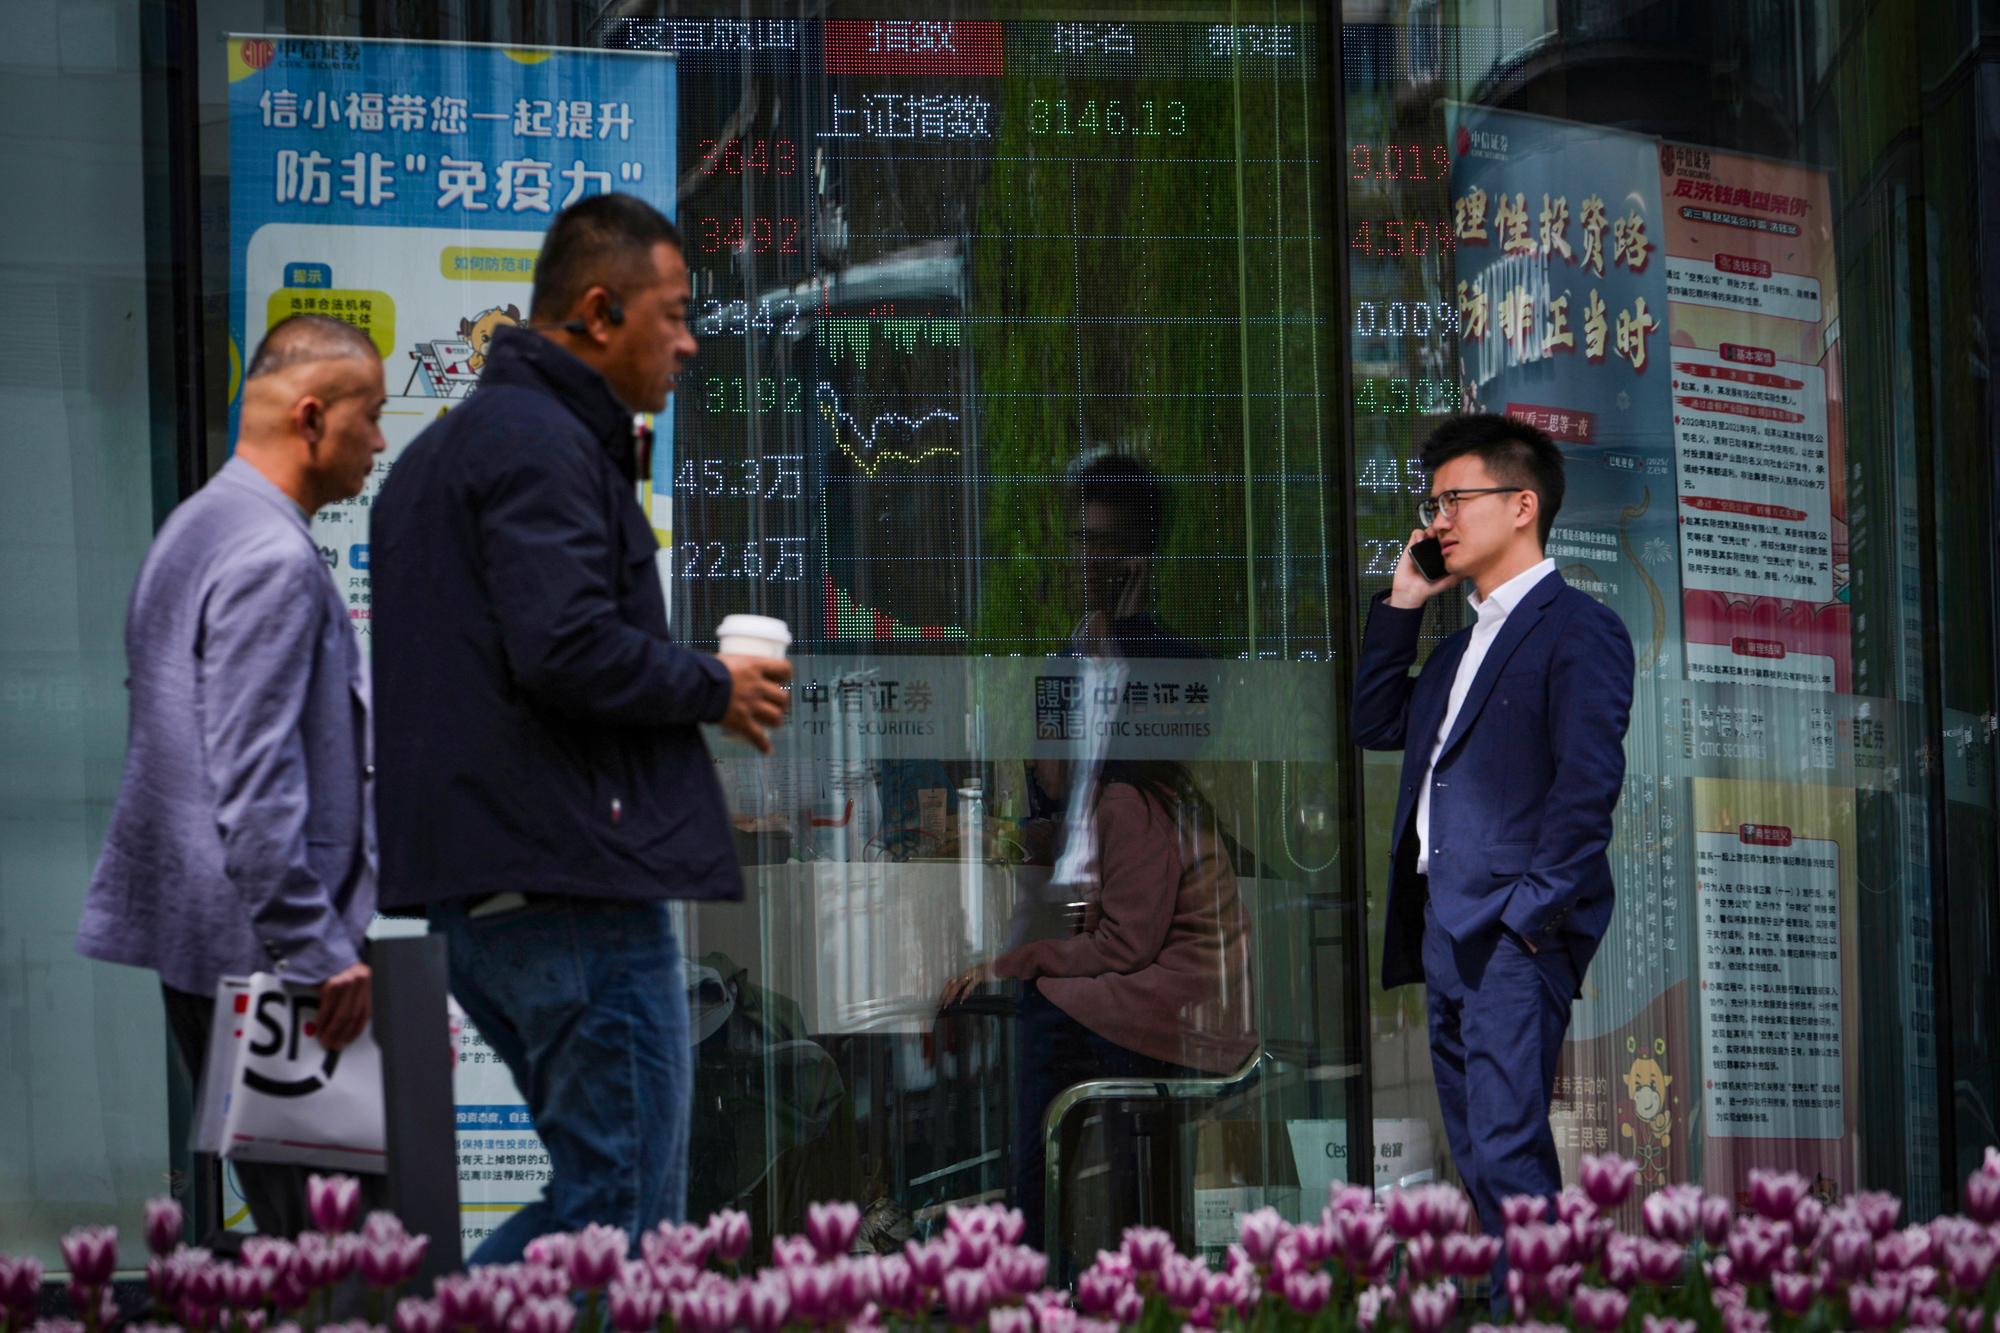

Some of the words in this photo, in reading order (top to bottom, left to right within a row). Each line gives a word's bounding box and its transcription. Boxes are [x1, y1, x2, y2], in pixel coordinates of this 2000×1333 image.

[260, 88, 636, 141] 信小福带您一起提升
[816, 93, 991, 138] 上证指数
[700, 140, 795, 174] 3643
[1672, 178, 1808, 218] 反洗钱典型案例
[701, 218, 800, 252] 3492
[1351, 221, 1456, 256] 4.50%
[1455, 187, 1650, 279] 理性投资路
[292, 269, 323, 284] 提示
[454, 256, 538, 273] 如何防范非
[290, 297, 372, 312] 选择合法机构
[703, 299, 800, 335] 3342
[1356, 301, 1459, 336] 0.00%
[1457, 281, 1654, 369] 防非正当时
[705, 378, 802, 412] 3192
[1356, 378, 1461, 413] 4.50%
[674, 455, 804, 498] 45.3万
[669, 537, 806, 580] 22.6万
[801, 680, 933, 713] 中信证券
[1094, 681, 1209, 715] 中信证券
[848, 721, 935, 735] ECURITIES
[1095, 721, 1130, 737] CITIC
[1135, 722, 1211, 737] SECURITIES
[455, 1139, 542, 1151] 保持理性投资的
